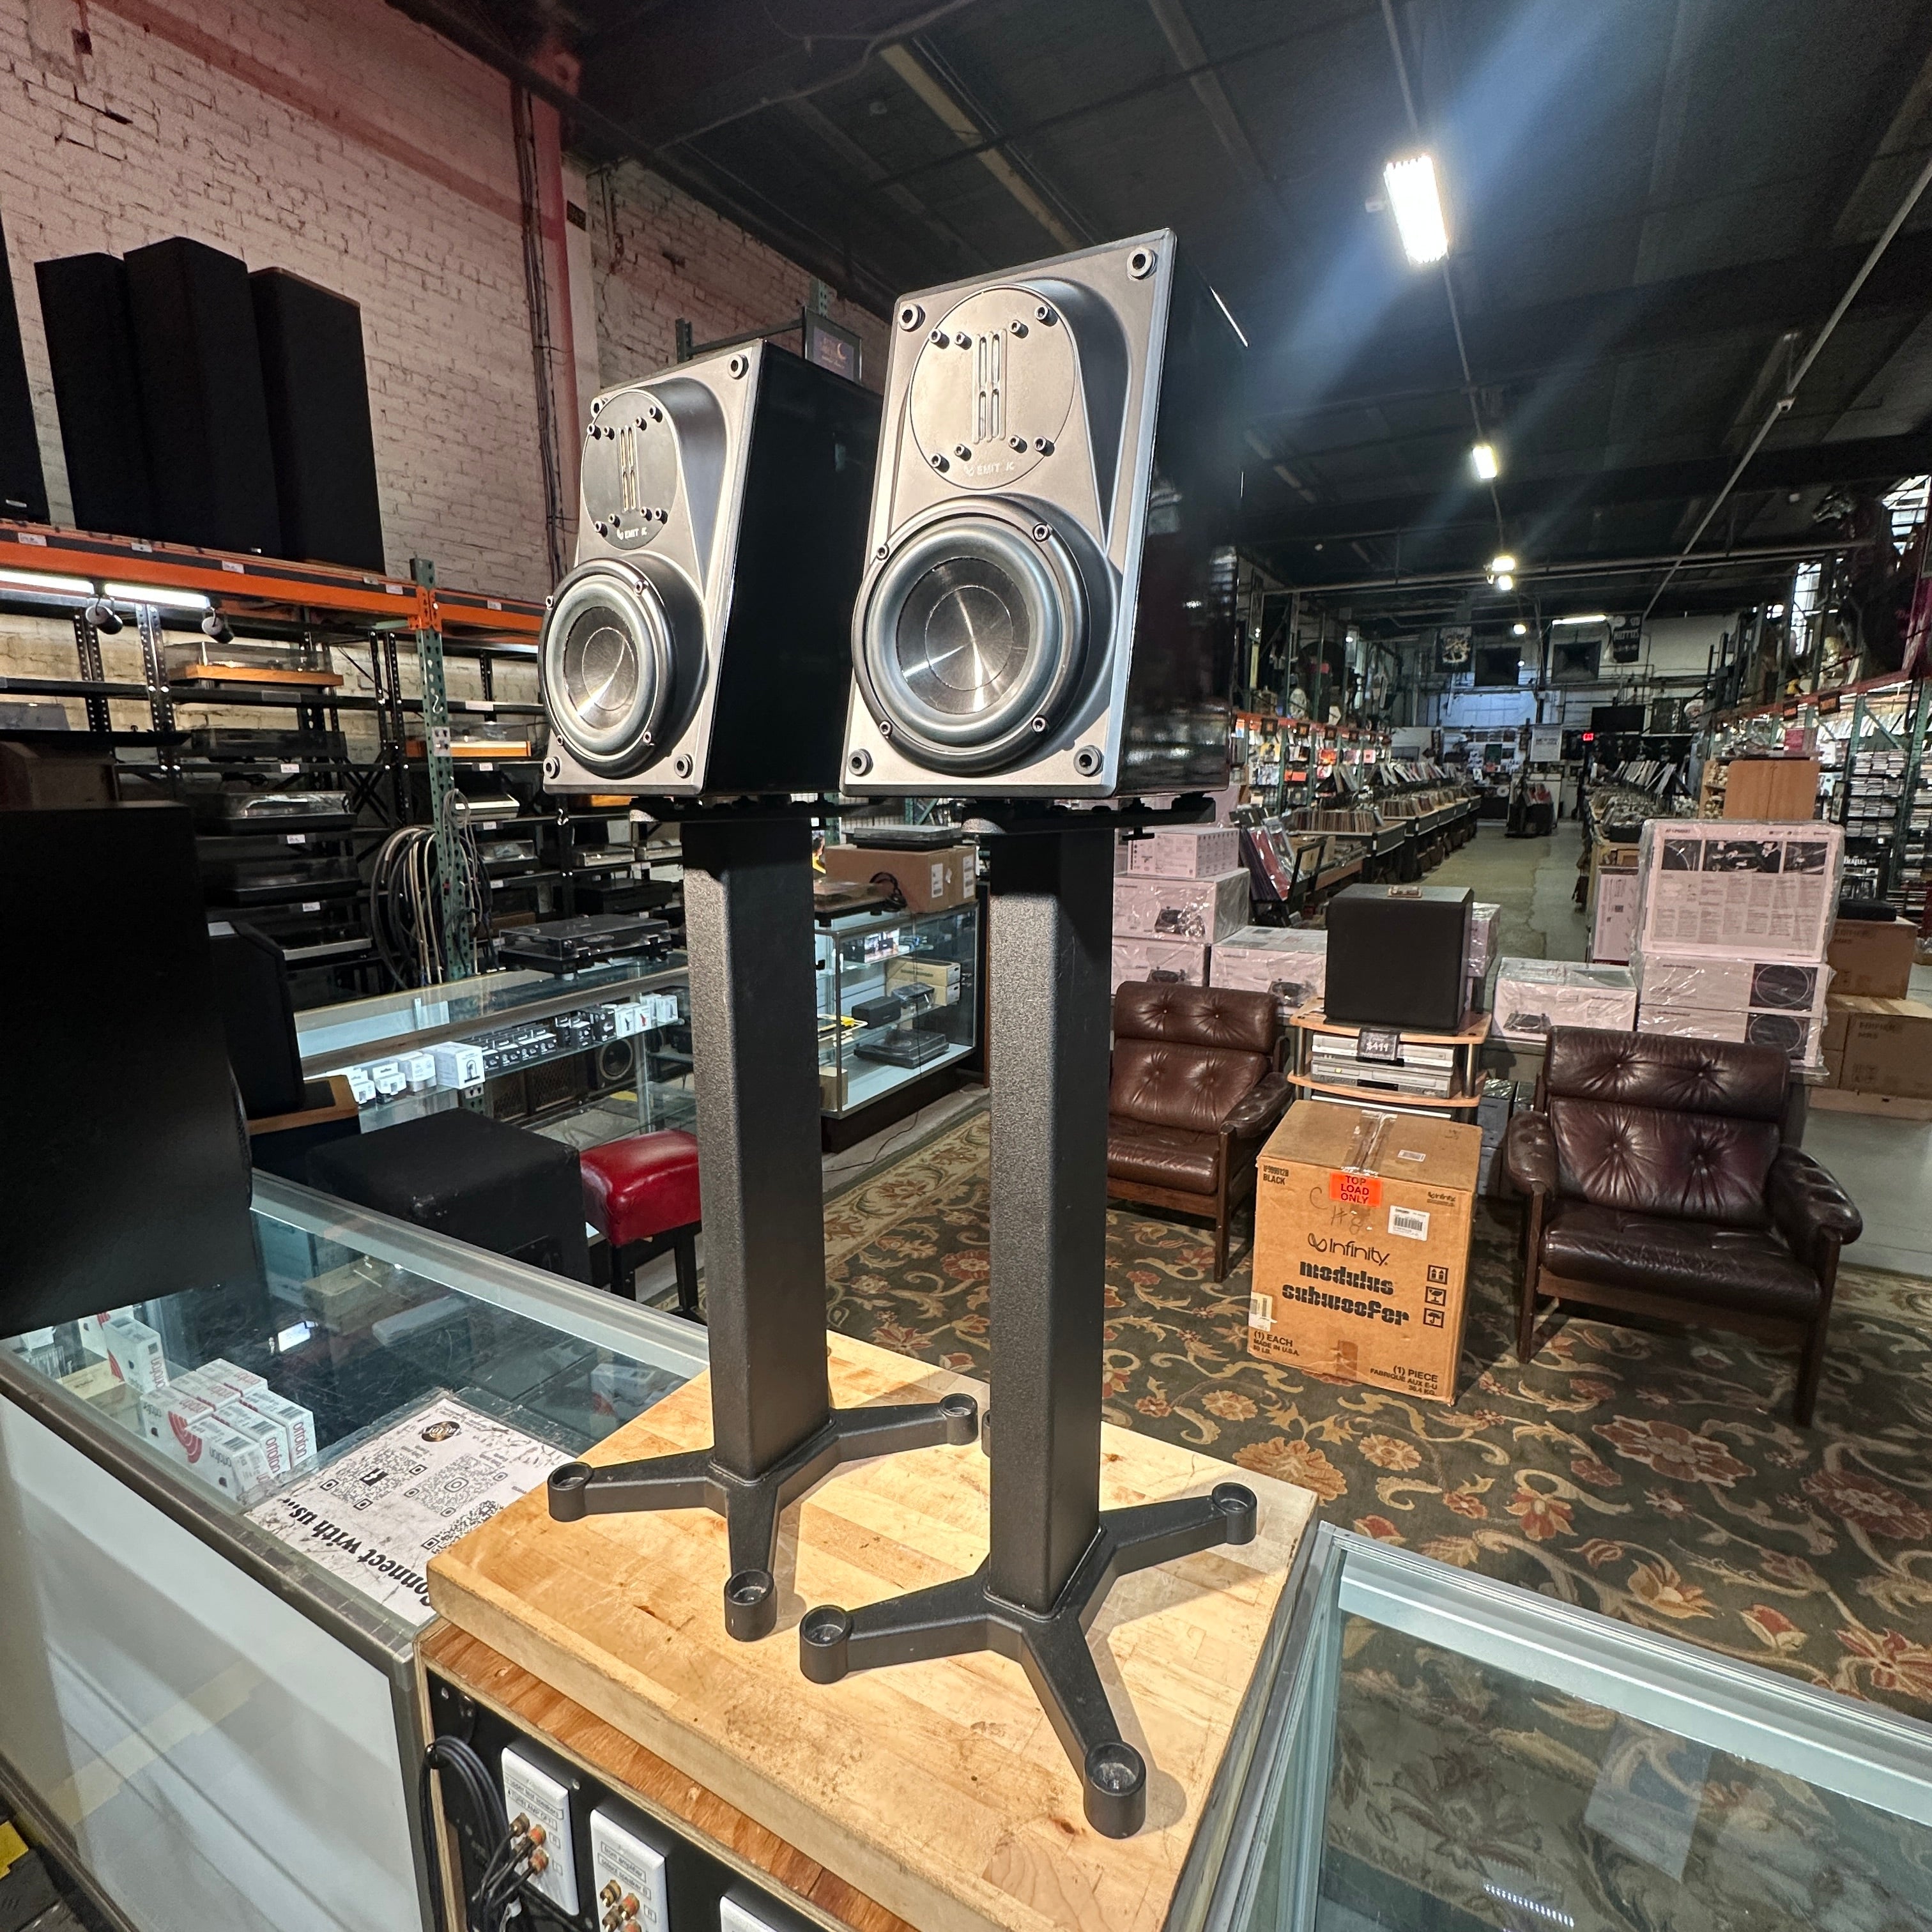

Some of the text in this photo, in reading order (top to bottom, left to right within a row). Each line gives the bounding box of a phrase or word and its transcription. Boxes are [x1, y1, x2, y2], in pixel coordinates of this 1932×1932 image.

[1263, 1173, 1285, 1185] BLACK
[1346, 1175, 1367, 1186] TOP
[1340, 1183, 1369, 1195] LOAD
[1340, 1193, 1369, 1204] ONLY
[1300, 1261, 1394, 1296] modulus
[1282, 1284, 1409, 1326] subwoofer
[1254, 1331, 1293, 1347] (1) EACH
[1254, 1338, 1272, 1349] MADE
[1370, 1368, 1406, 1383] FABRIQUE
[1407, 1378, 1423, 1387] AUX
[1393, 1365, 1439, 1383] (1) PIECE
[293, 1422, 307, 1459] ortofon
[266, 1437, 282, 1474] ortofon
[311, 1520, 362, 1554] with
